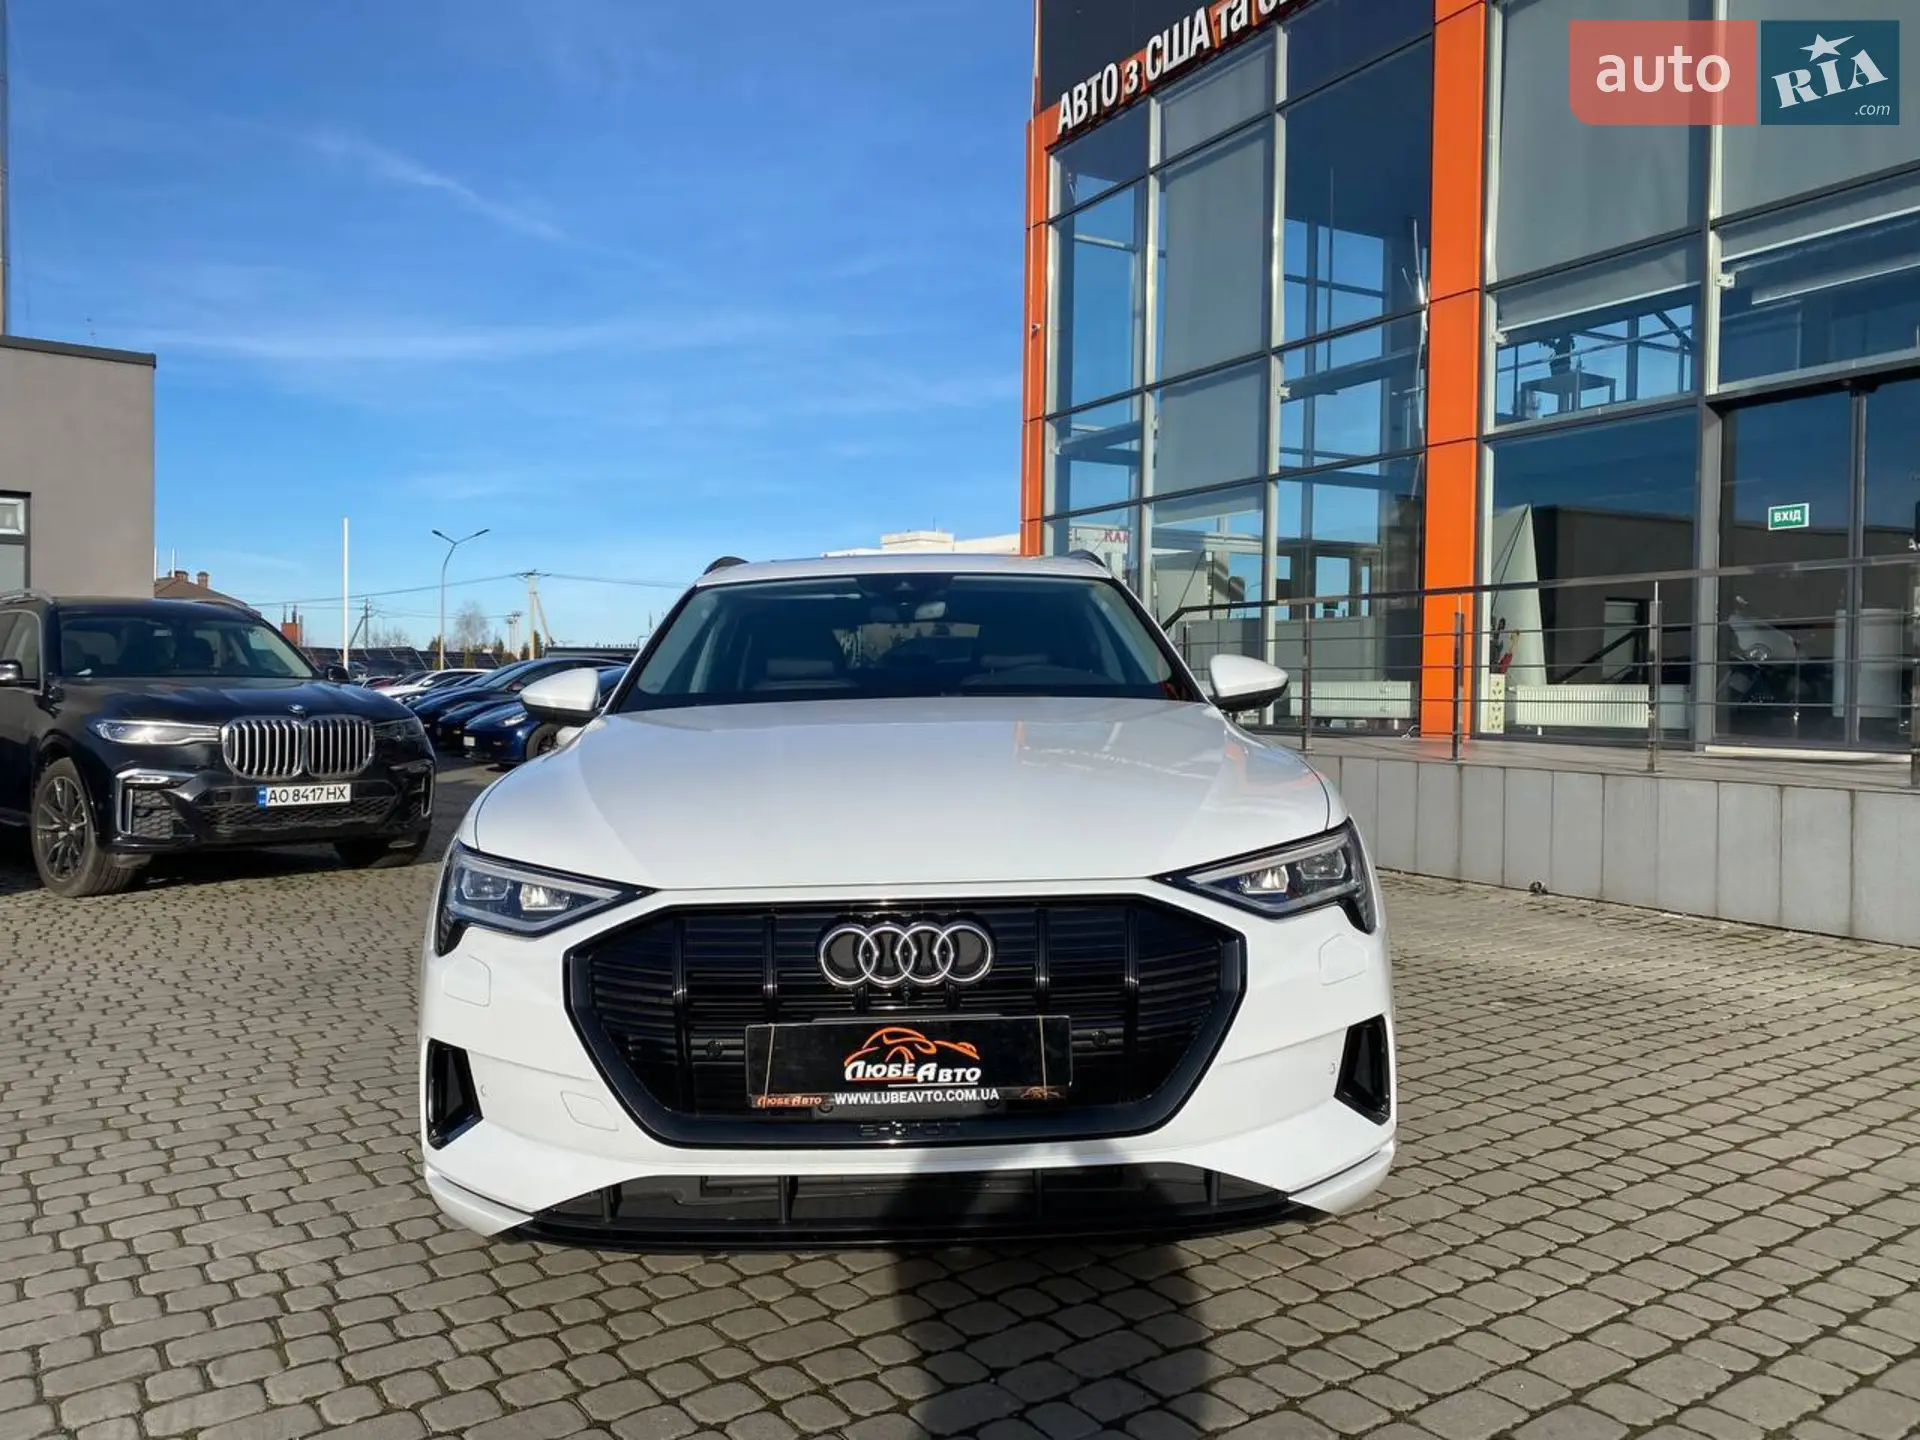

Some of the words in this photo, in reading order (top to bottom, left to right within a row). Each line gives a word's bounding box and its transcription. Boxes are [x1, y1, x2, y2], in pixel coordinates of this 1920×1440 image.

[1057, 62, 1119, 135] АВТО
[1145, 6, 1211, 82] США
[1774, 509, 1802, 523] ВХІД
[268, 788, 289, 804] AO
[292, 787, 325, 803] 8417
[326, 785, 347, 801] HX
[834, 1088, 1000, 1105] WWW.LUBEAVTO.COM.UA
